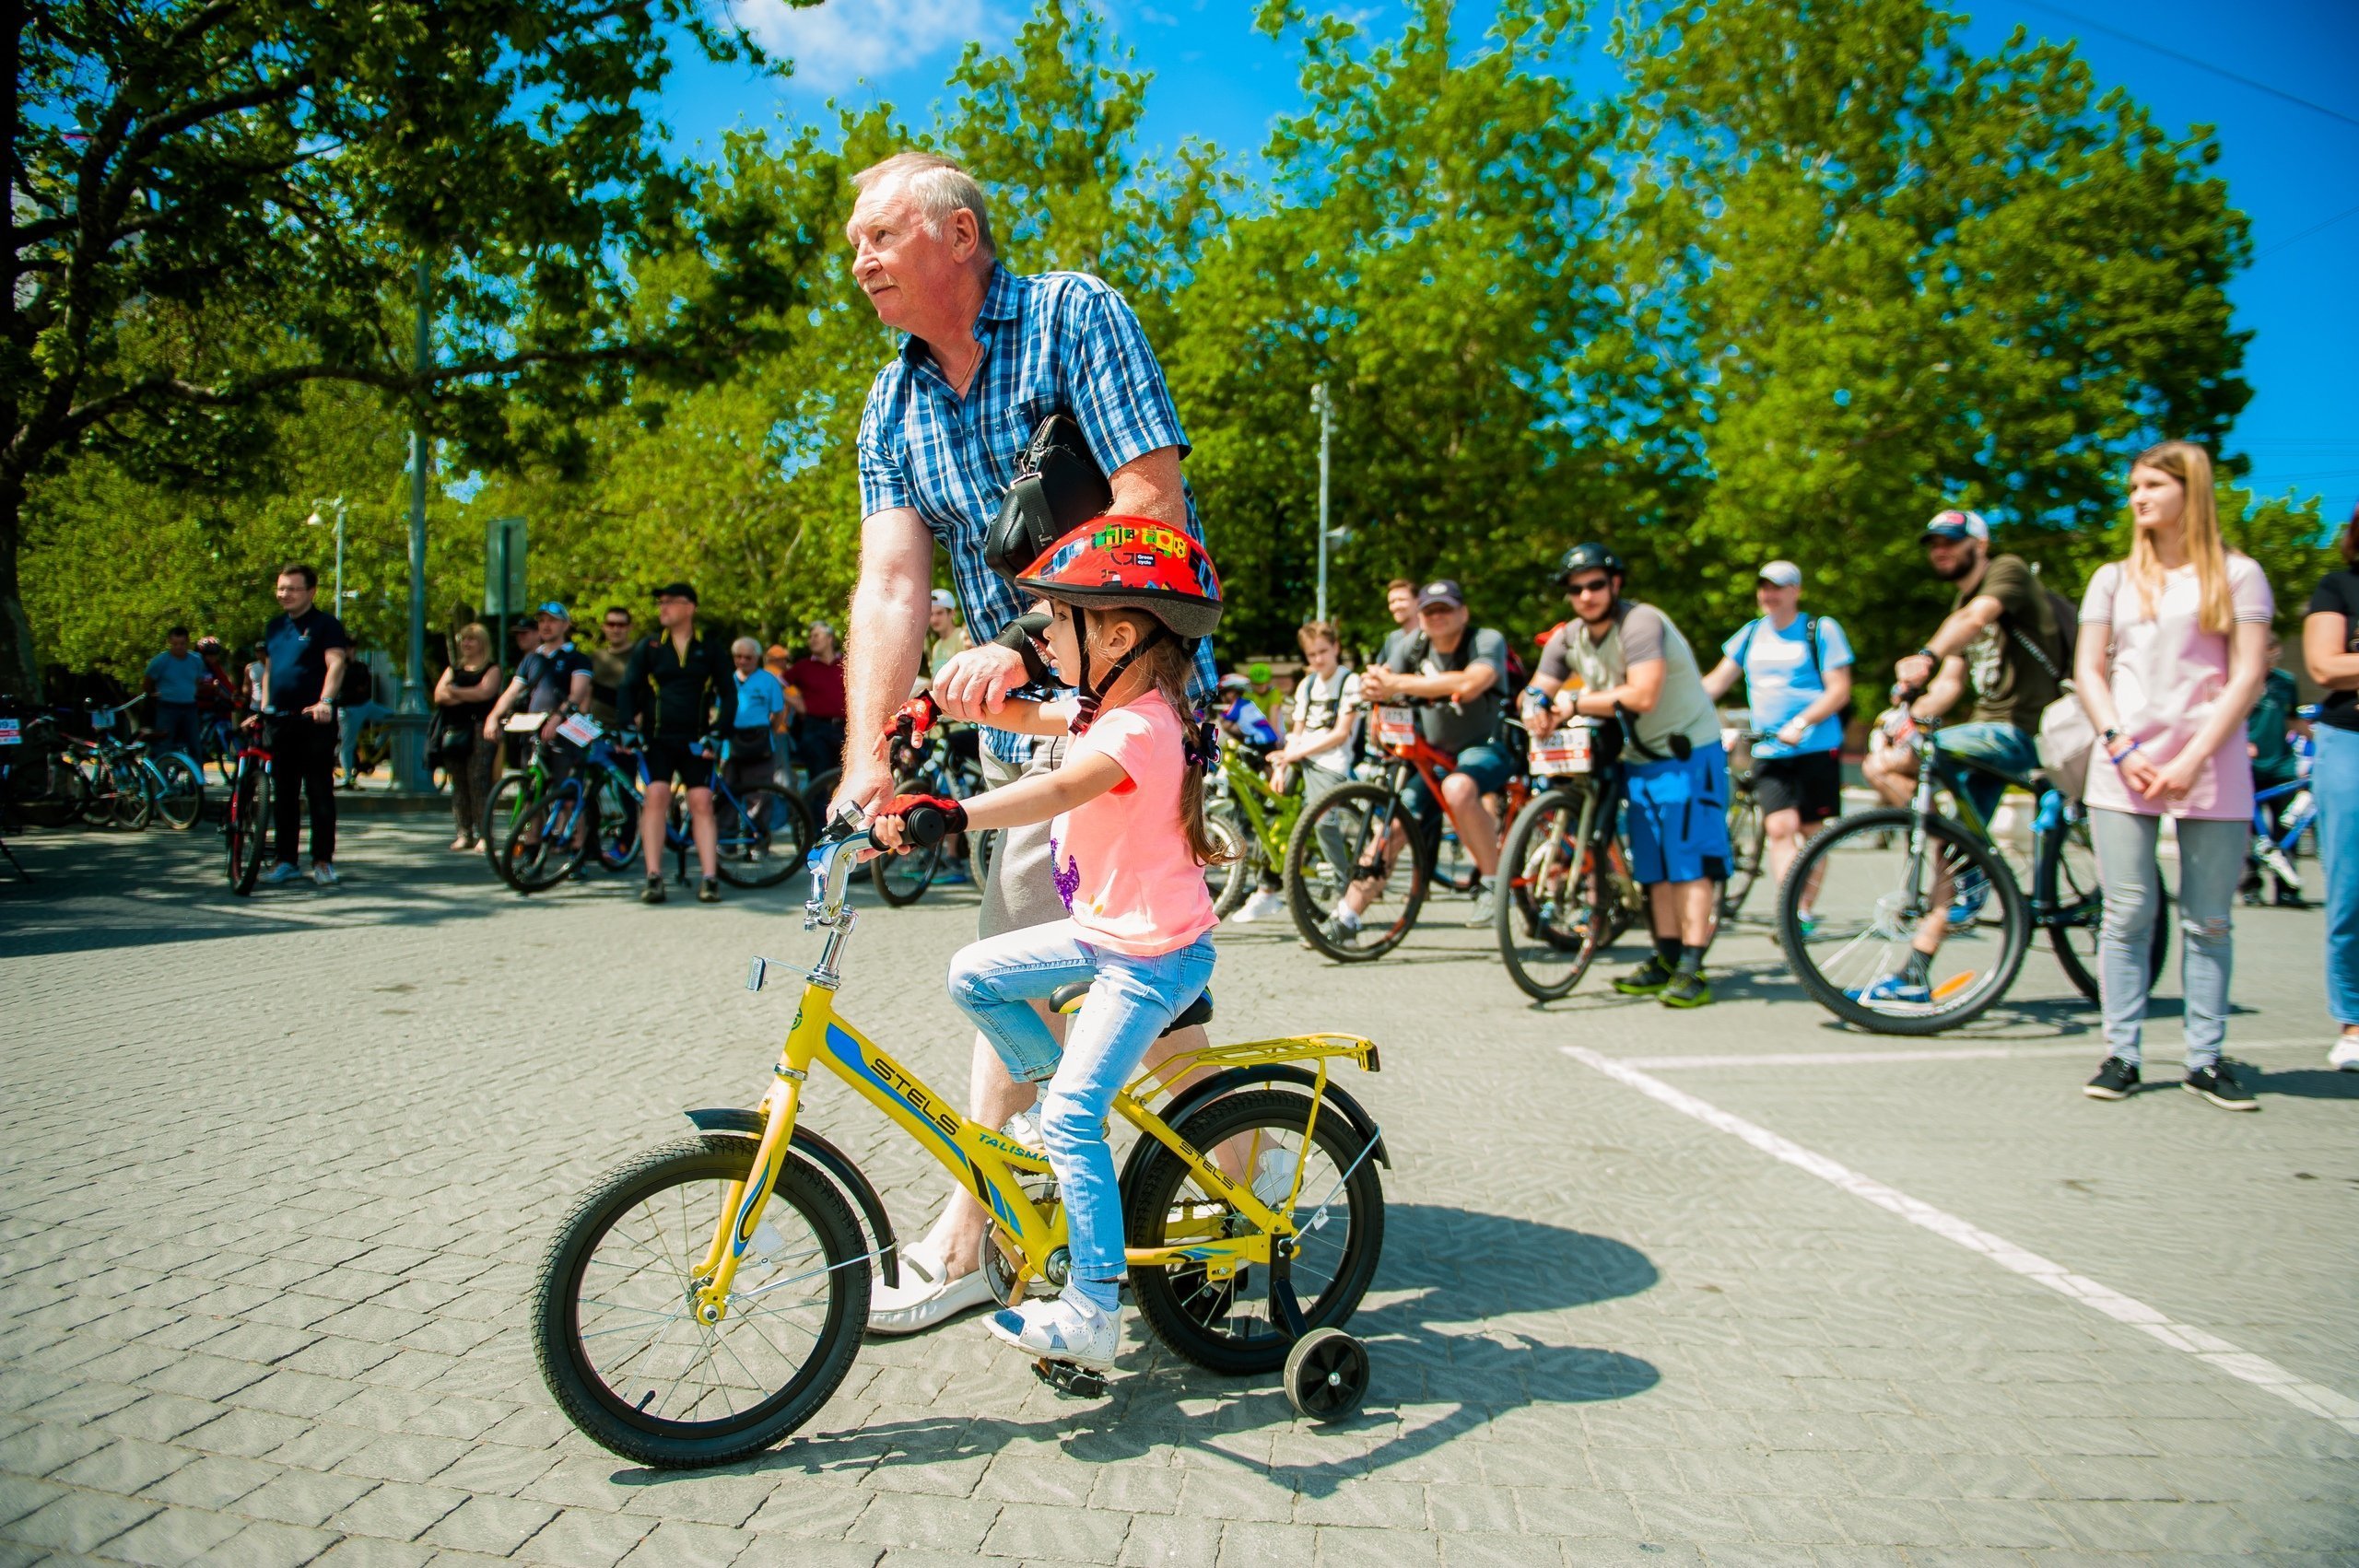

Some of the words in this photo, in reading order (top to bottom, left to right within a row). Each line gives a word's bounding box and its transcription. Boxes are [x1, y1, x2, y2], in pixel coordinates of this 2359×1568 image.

[870, 1058, 960, 1136] STELS
[979, 1132, 1050, 1163] TALISMA
[1179, 1141, 1236, 1191] STELS
